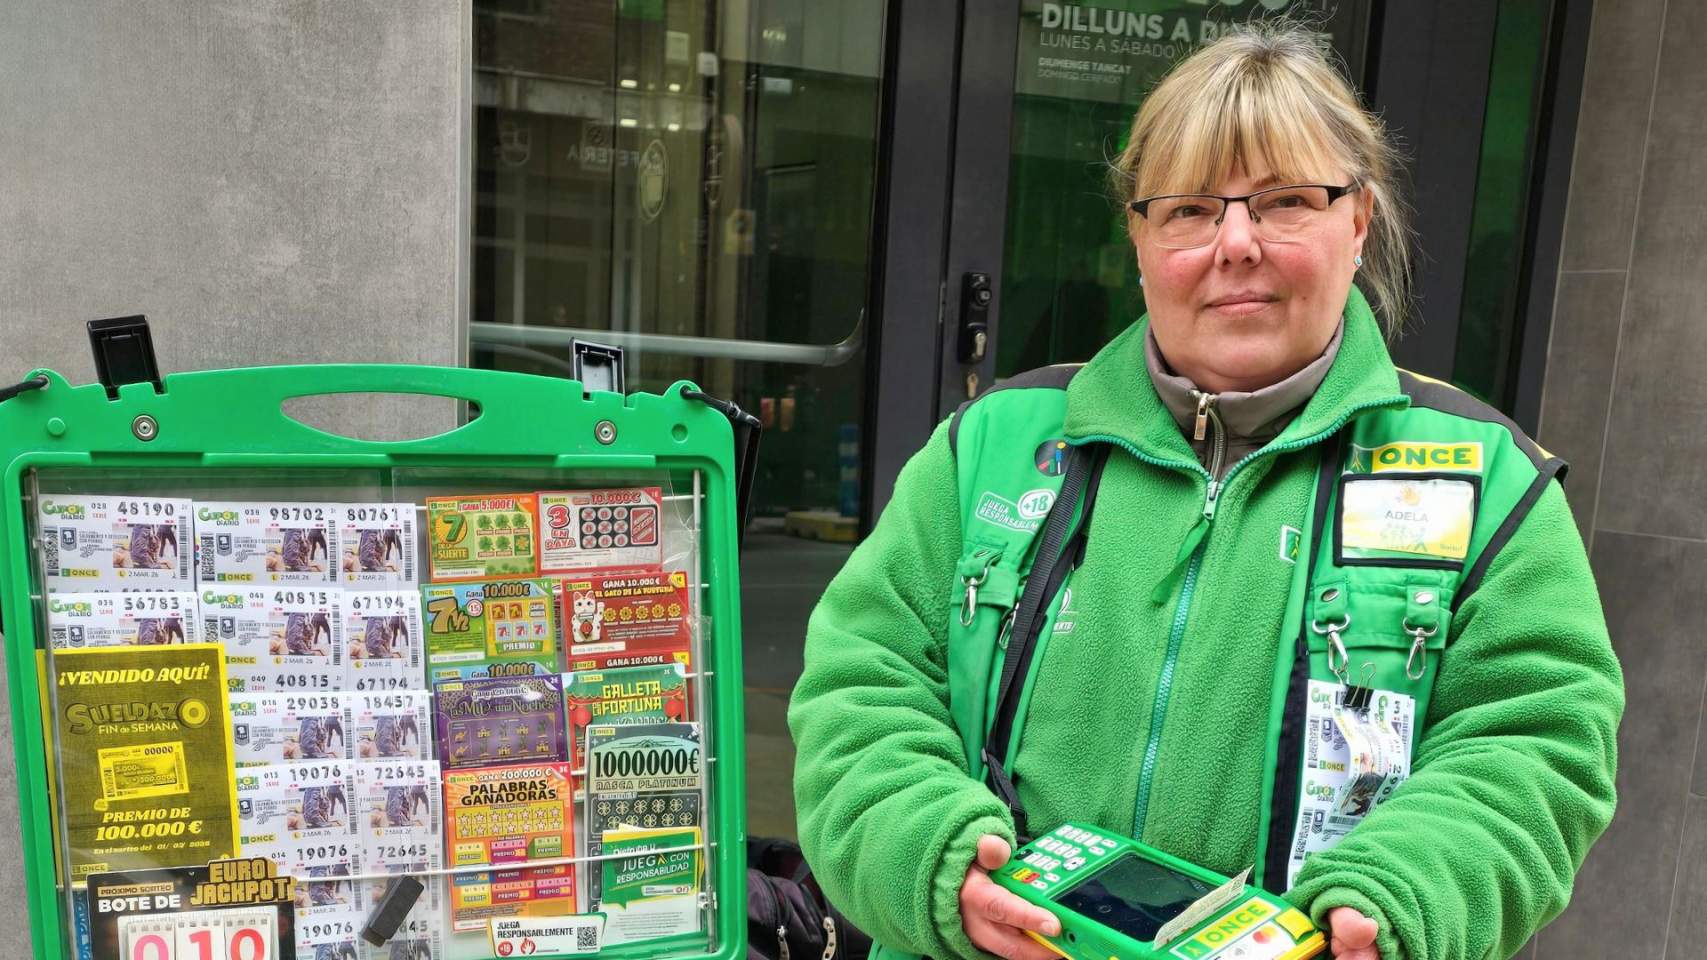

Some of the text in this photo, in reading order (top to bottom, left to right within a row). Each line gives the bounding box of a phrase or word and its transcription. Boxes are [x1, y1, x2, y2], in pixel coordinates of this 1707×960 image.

[1042, 3, 1163, 40] DILLUNS
[1170, 17, 1191, 42] A
[1040, 32, 1175, 58] LUNES A SÁBADO
[1092, 63, 1132, 74] TANCAT
[1380, 448, 1472, 465] ONCE
[117, 501, 174, 516] 48190
[983, 499, 1009, 514] JUEGA
[1023, 495, 1049, 513] +18
[270, 508, 324, 521] 98702
[348, 508, 398, 521] 80761
[547, 505, 570, 528] 3
[1385, 510, 1429, 523] ADELA
[443, 514, 465, 542] 7
[552, 529, 569, 538] EN
[545, 538, 576, 550] RAYA
[438, 550, 467, 558] SUERTE
[603, 580, 626, 588] GANA
[627, 578, 655, 587] 10.000
[483, 583, 530, 598] 10.000€
[125, 597, 179, 610] 56783
[275, 592, 328, 605] 40815
[353, 596, 404, 609] 67194
[503, 641, 535, 650] PREMIO
[607, 658, 629, 666] GANA
[631, 656, 658, 665] 10.000
[59, 663, 210, 686] ¡VENDIDO AQUÍ!
[488, 663, 535, 677] 10.000€
[276, 675, 329, 688] 40815
[356, 676, 408, 691] 67194
[602, 681, 661, 698] GALLETA
[287, 697, 339, 710] 29038
[365, 696, 413, 709] 18457
[602, 697, 662, 715] FORTUNA
[65, 698, 210, 735] SUELDAZO
[98, 724, 118, 735] FIN
[131, 723, 179, 733] SEMANA
[144, 746, 173, 755] 00000
[290, 765, 341, 781] 19076
[375, 766, 425, 779] 72645
[1327, 763, 1345, 772] ONCE
[470, 780, 547, 795] PALABRAS
[638, 777, 696, 788] PLATINUM
[461, 789, 556, 806] GANADORAS
[102, 807, 192, 823] PREMIO DE
[96, 820, 203, 842] 100.000 €
[297, 844, 347, 860] 19076
[378, 844, 428, 858] 72645
[623, 852, 690, 872] JUEGA CON
[209, 859, 267, 883] EURO
[616, 862, 689, 884] RESPONSABILIDAD
[140, 885, 172, 893] SORTEO
[190, 878, 290, 906] JACKPOT
[98, 895, 181, 912] BOTE DE
[400, 920, 428, 932] 645
[497, 921, 520, 929] JUEGA
[1205, 904, 1267, 942] ONCE
[302, 923, 353, 938] 19076
[497, 927, 573, 939] RESPONSABLEMENTE
